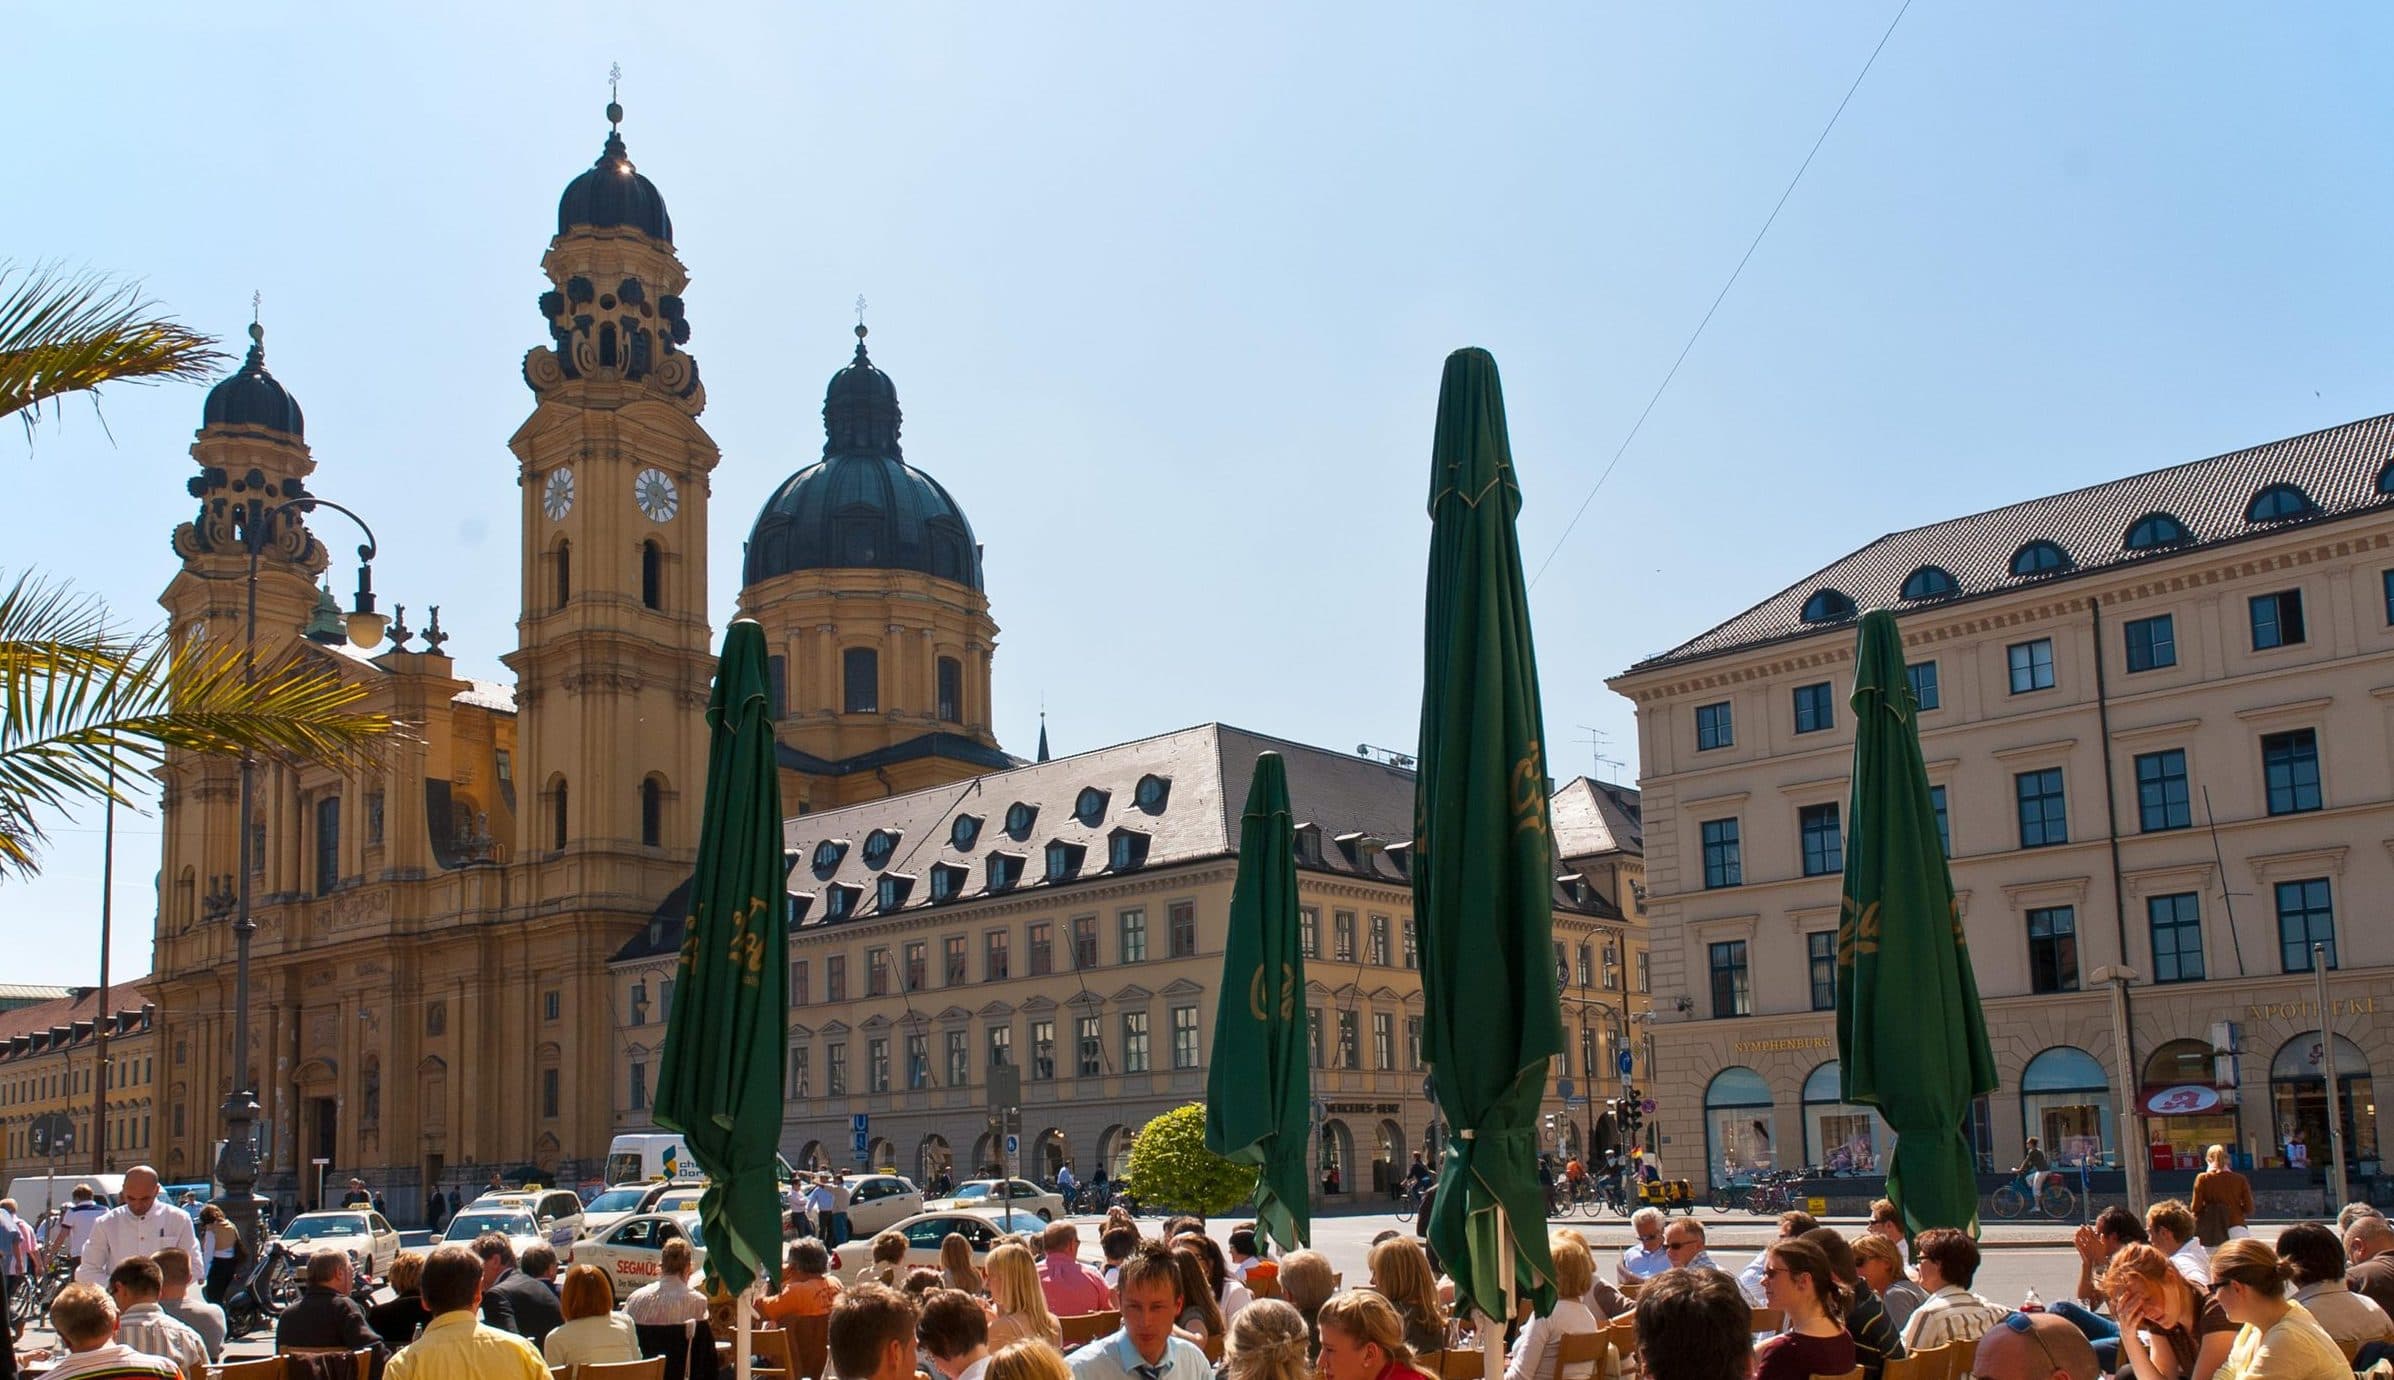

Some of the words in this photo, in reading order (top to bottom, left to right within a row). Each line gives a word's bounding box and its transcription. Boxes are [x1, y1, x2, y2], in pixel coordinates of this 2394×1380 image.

[1735, 1038, 1831, 1052] NYMPHENBURG
[855, 1114, 867, 1131] U
[616, 1260, 658, 1276] SEGMÜL
